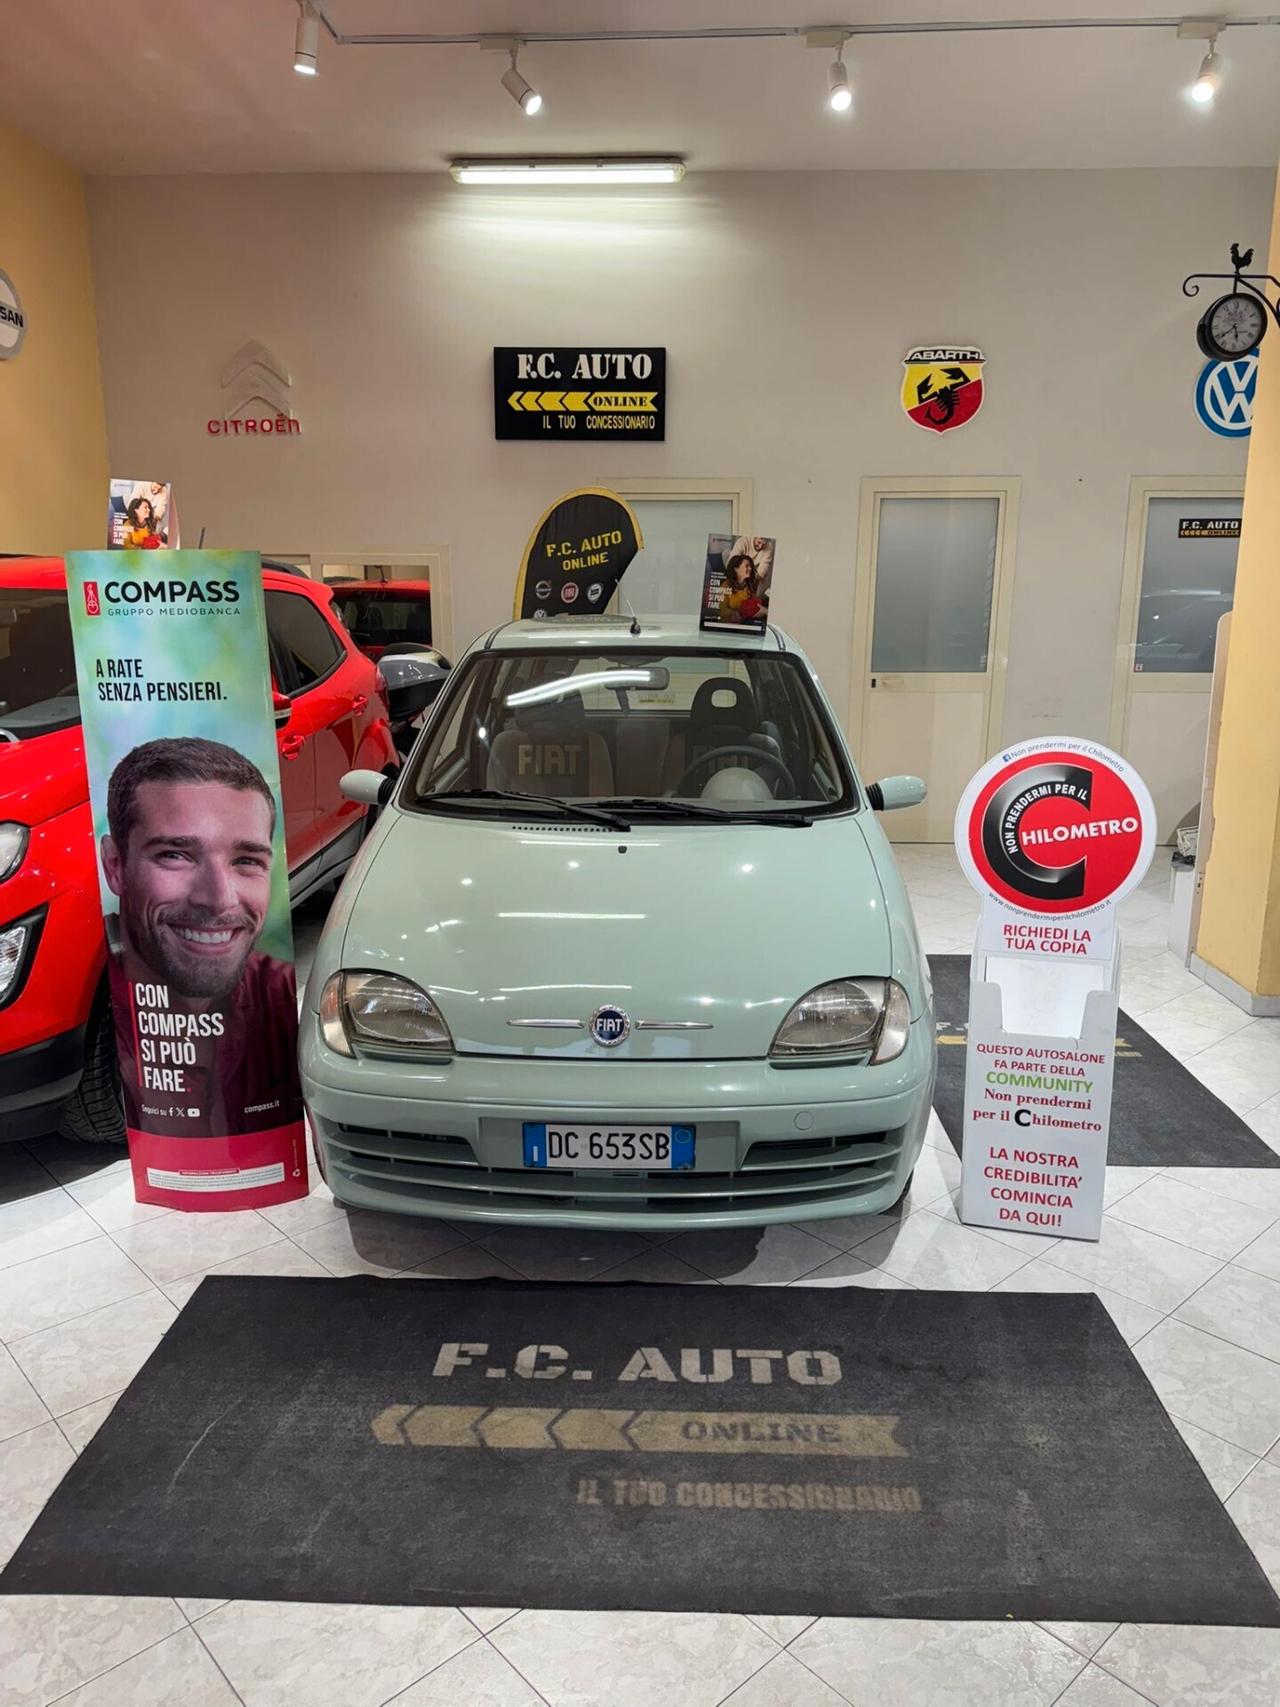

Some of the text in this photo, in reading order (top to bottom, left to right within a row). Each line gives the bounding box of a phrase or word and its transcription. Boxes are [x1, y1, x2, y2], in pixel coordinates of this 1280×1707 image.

[910, 350, 979, 360] ABARTH
[517, 353, 653, 380] F.C. AUTO
[593, 396, 648, 407] ONLINE
[542, 415, 655, 430] IL TUO CONCESSIONARIO
[1207, 521, 1239, 530] AUTO
[546, 530, 623, 558] F.C. AUTO
[562, 552, 609, 571] ONLINE
[104, 581, 240, 603] COMPASS
[107, 607, 241, 616] GRUPPO MEDIOBANCA
[96, 659, 144, 678] A RATE
[98, 682, 228, 702] SENZA PENSIERI.
[518, 744, 582, 776] FIAT
[1011, 749, 1027, 758] Non
[1027, 742, 1067, 753] prendermi
[1088, 746, 1125, 773] Chilometro
[1004, 783, 1089, 855] NON PRENDERMI PER IL
[1003, 924, 1092, 942] RICHIEDI LA
[1005, 938, 1087, 955] TUA COPIA
[135, 982, 169, 1008] CON
[138, 1011, 225, 1037] COMPASS
[596, 1018, 623, 1032] FIAT
[140, 1037, 196, 1065] SI PUÒ
[976, 1044, 1024, 1056] QUESTO
[1026, 1048, 1105, 1064] AUTOSALONE
[994, 1060, 1085, 1077] FA PARTE DELLA
[986, 1071, 1094, 1094] COMMUNITY
[244, 1100, 280, 1114] compass.it
[984, 1088, 1092, 1111] Non prendermi
[972, 1109, 1102, 1132] per il Chilometro
[548, 1131, 670, 1161] DC 653SB
[989, 1147, 1079, 1169] LA NOSTRA
[990, 1187, 1073, 1209] COMINCIA
[999, 1207, 1062, 1227] DA QUI!
[431, 1343, 843, 1385] F.C. AUTO
[682, 1420, 840, 1445] ONLINE
